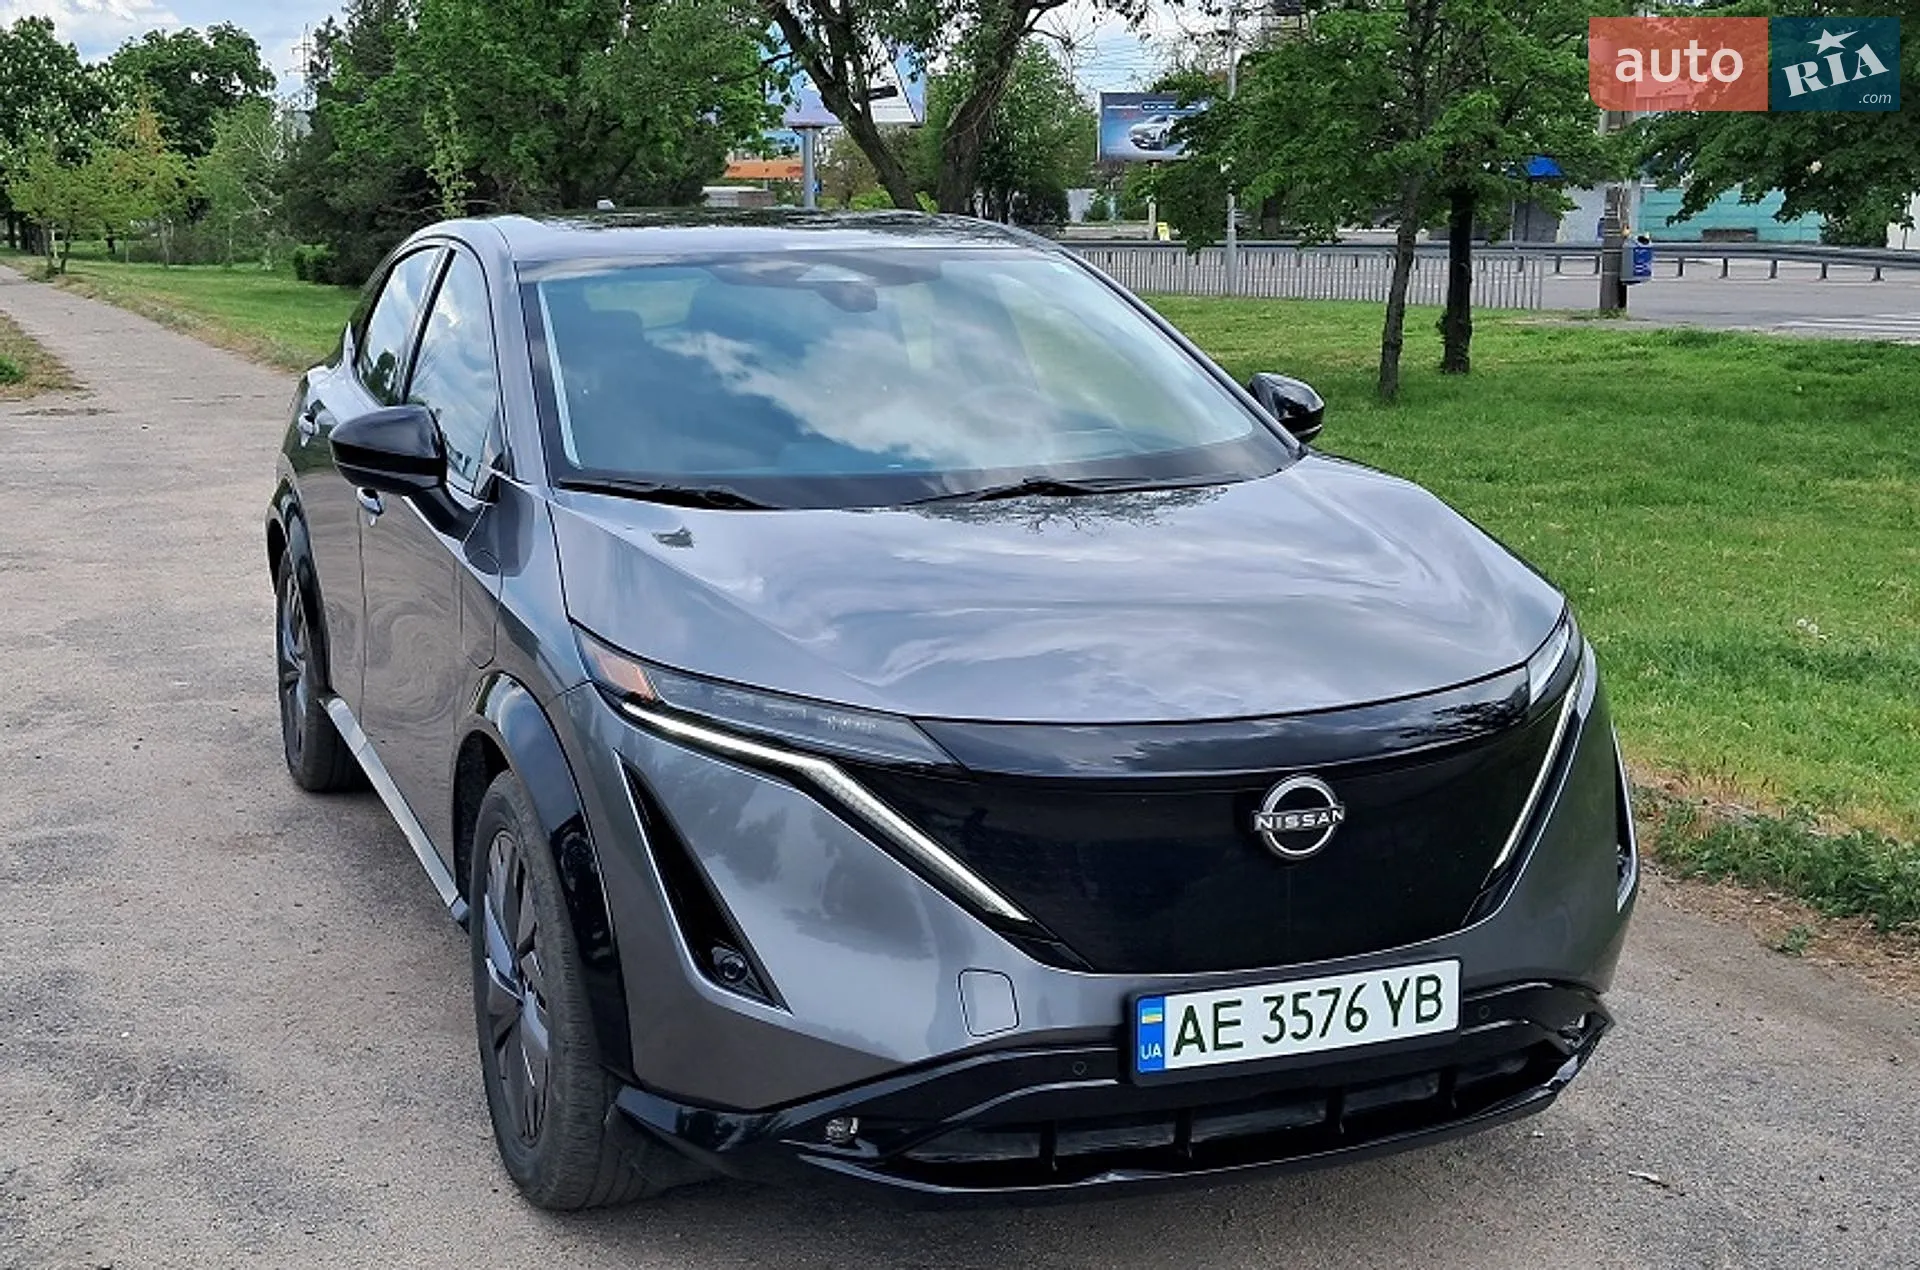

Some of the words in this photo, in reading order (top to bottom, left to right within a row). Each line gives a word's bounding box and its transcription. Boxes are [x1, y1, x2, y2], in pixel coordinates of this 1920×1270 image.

[1255, 808, 1345, 831] NISSAN
[1173, 1000, 1244, 1056] AE
[1262, 982, 1369, 1045] 3576
[1382, 974, 1443, 1027] YB
[1141, 1044, 1163, 1060] UA
